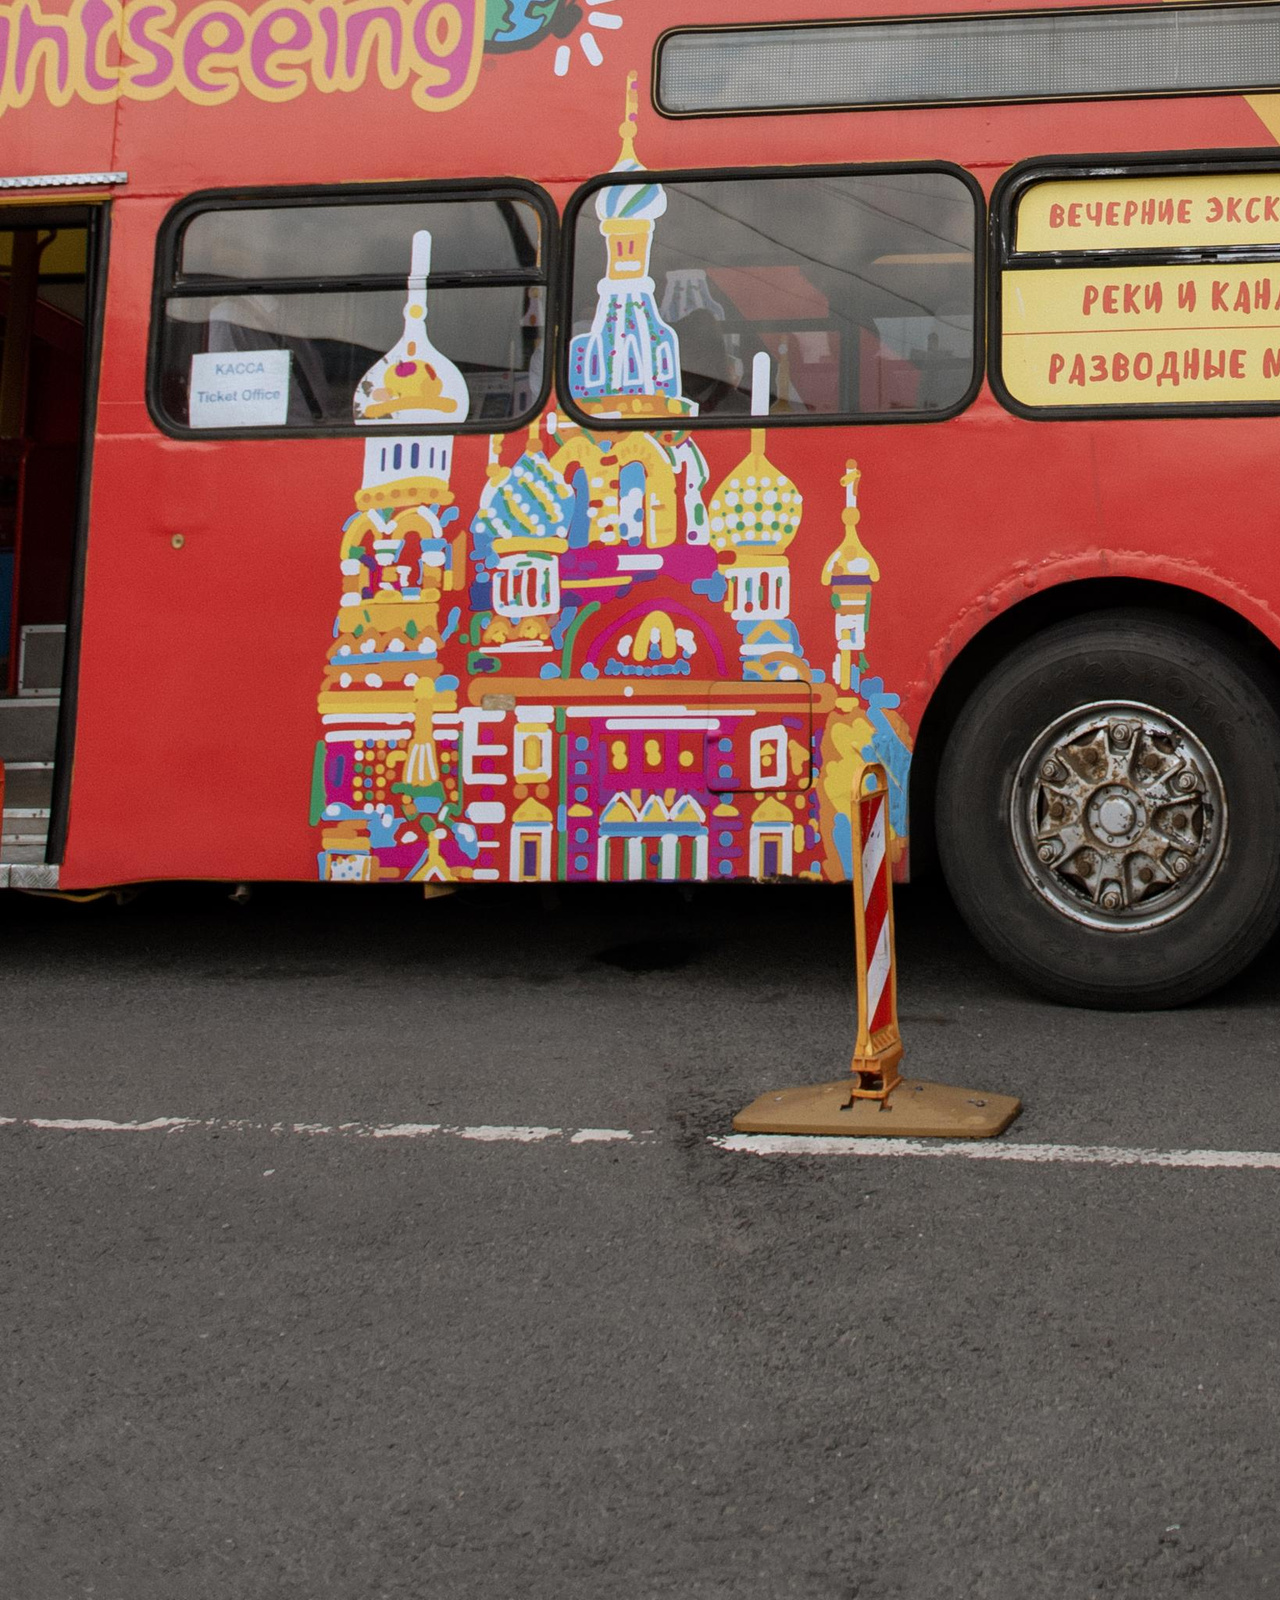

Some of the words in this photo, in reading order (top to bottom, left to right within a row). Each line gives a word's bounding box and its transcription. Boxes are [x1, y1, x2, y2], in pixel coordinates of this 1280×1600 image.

[1049, 198, 1193, 228] ВЕЧЕРНИЕ
[1082, 281, 1163, 316] РЕКИ
[1178, 280, 1197, 313] И
[215, 362, 265, 375] КАССА
[1048, 348, 1247, 387] РАЗВОДНЫЕ
[197, 391, 237, 404] Ticket
[241, 388, 281, 401] Office
